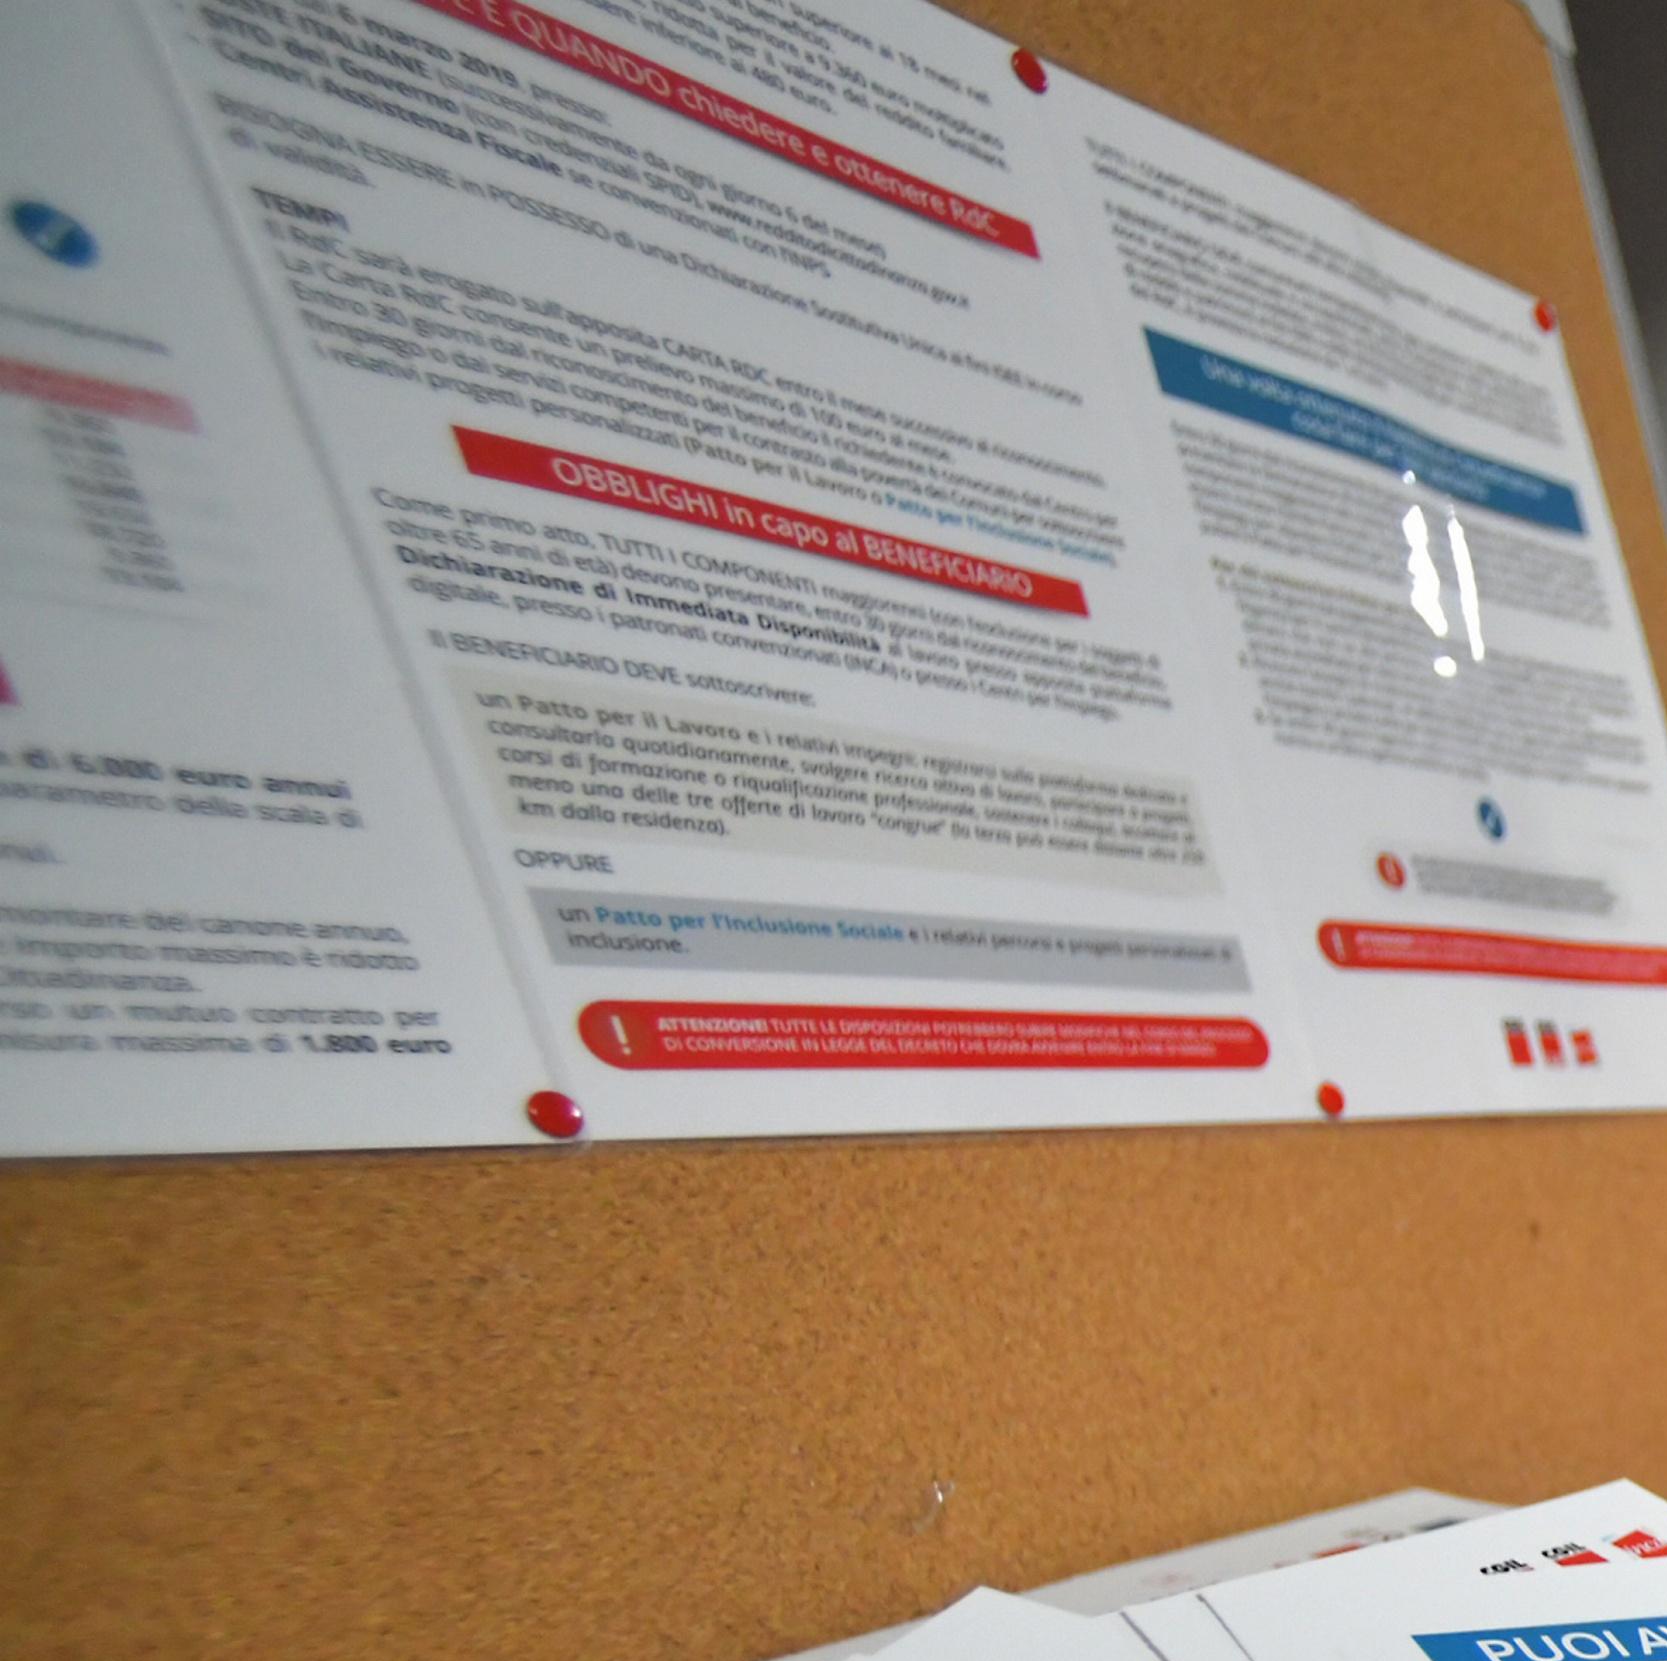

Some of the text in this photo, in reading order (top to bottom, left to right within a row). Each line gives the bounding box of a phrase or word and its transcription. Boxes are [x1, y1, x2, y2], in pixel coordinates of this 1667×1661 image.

[550, 456, 1034, 599] OBBLIGHI in capo al BENEFICIARIO
[394, 543, 882, 654] Dichiarazione di Immediata Disponibilità
[514, 848, 613, 875] OPPURE
[555, 905, 906, 943] un Patto per l'Inclusione Sociale
[565, 930, 690, 955] inclusione.
